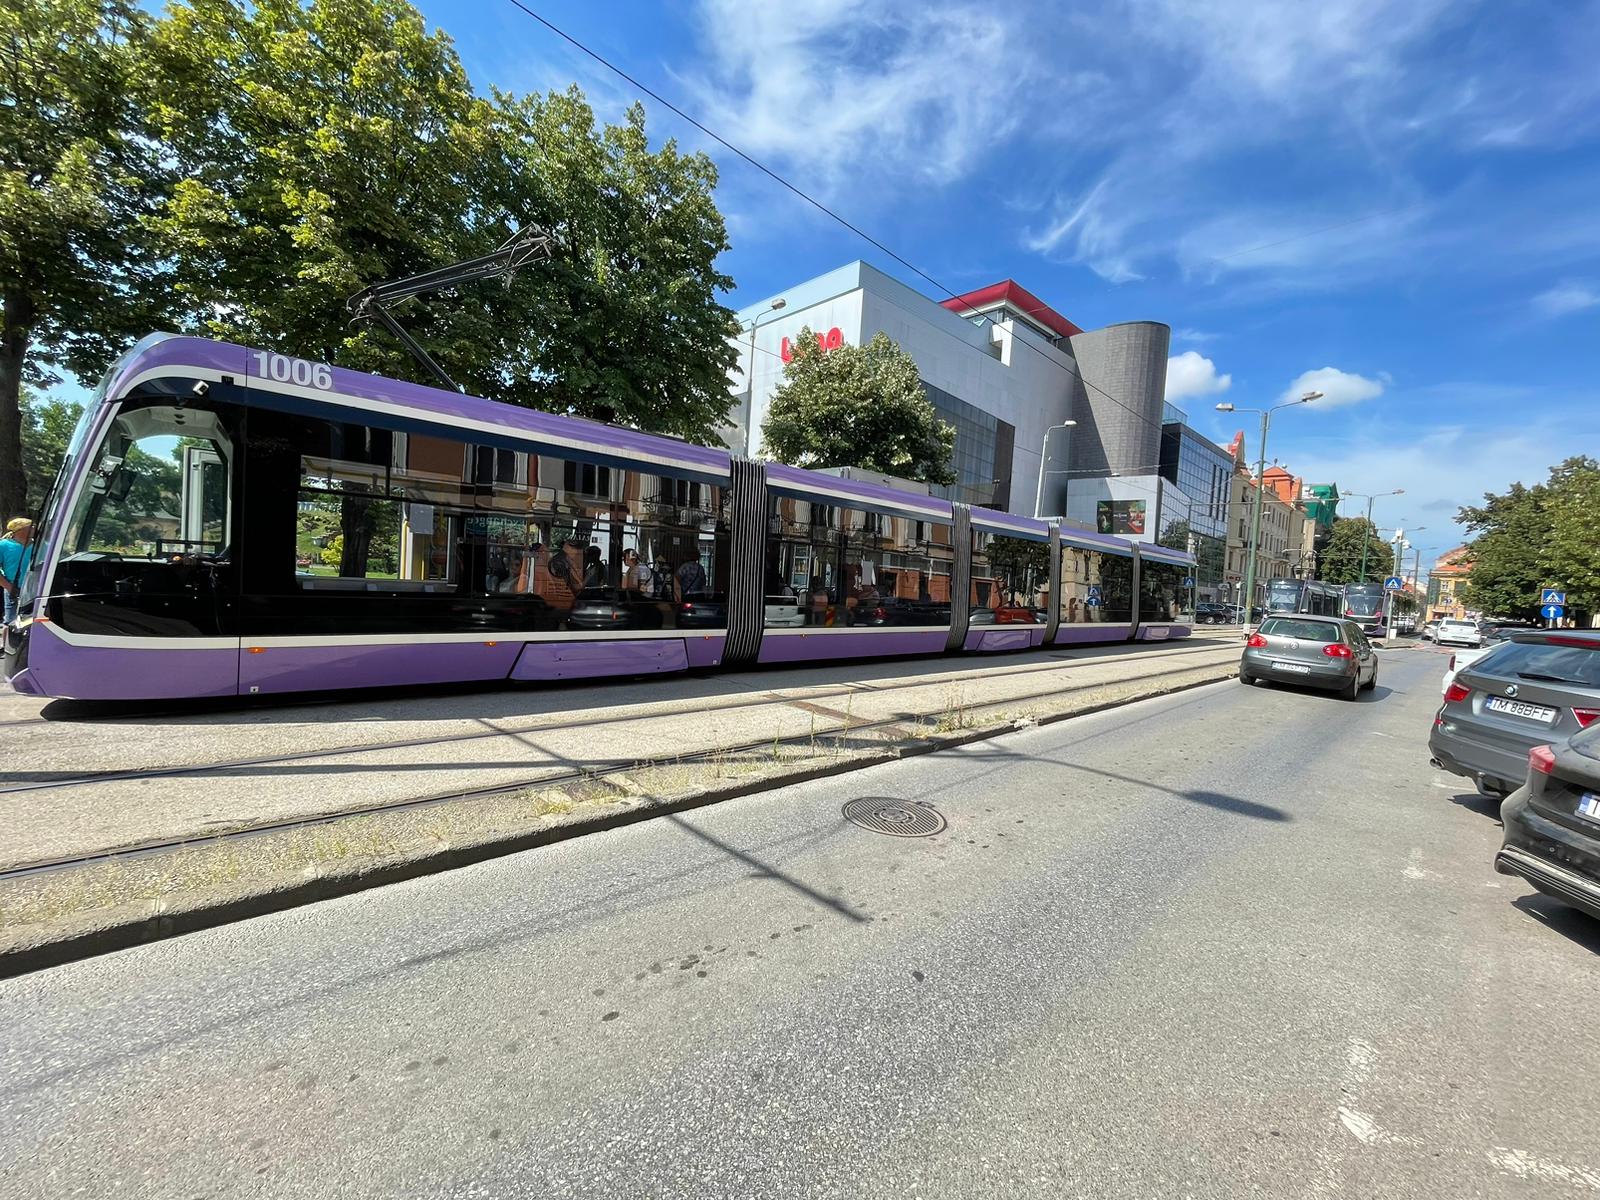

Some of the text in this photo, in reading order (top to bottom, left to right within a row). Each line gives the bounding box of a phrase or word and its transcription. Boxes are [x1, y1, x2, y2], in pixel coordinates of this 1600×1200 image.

[253, 351, 332, 390] 1006
[1492, 698, 1552, 719] TM 88BFF
